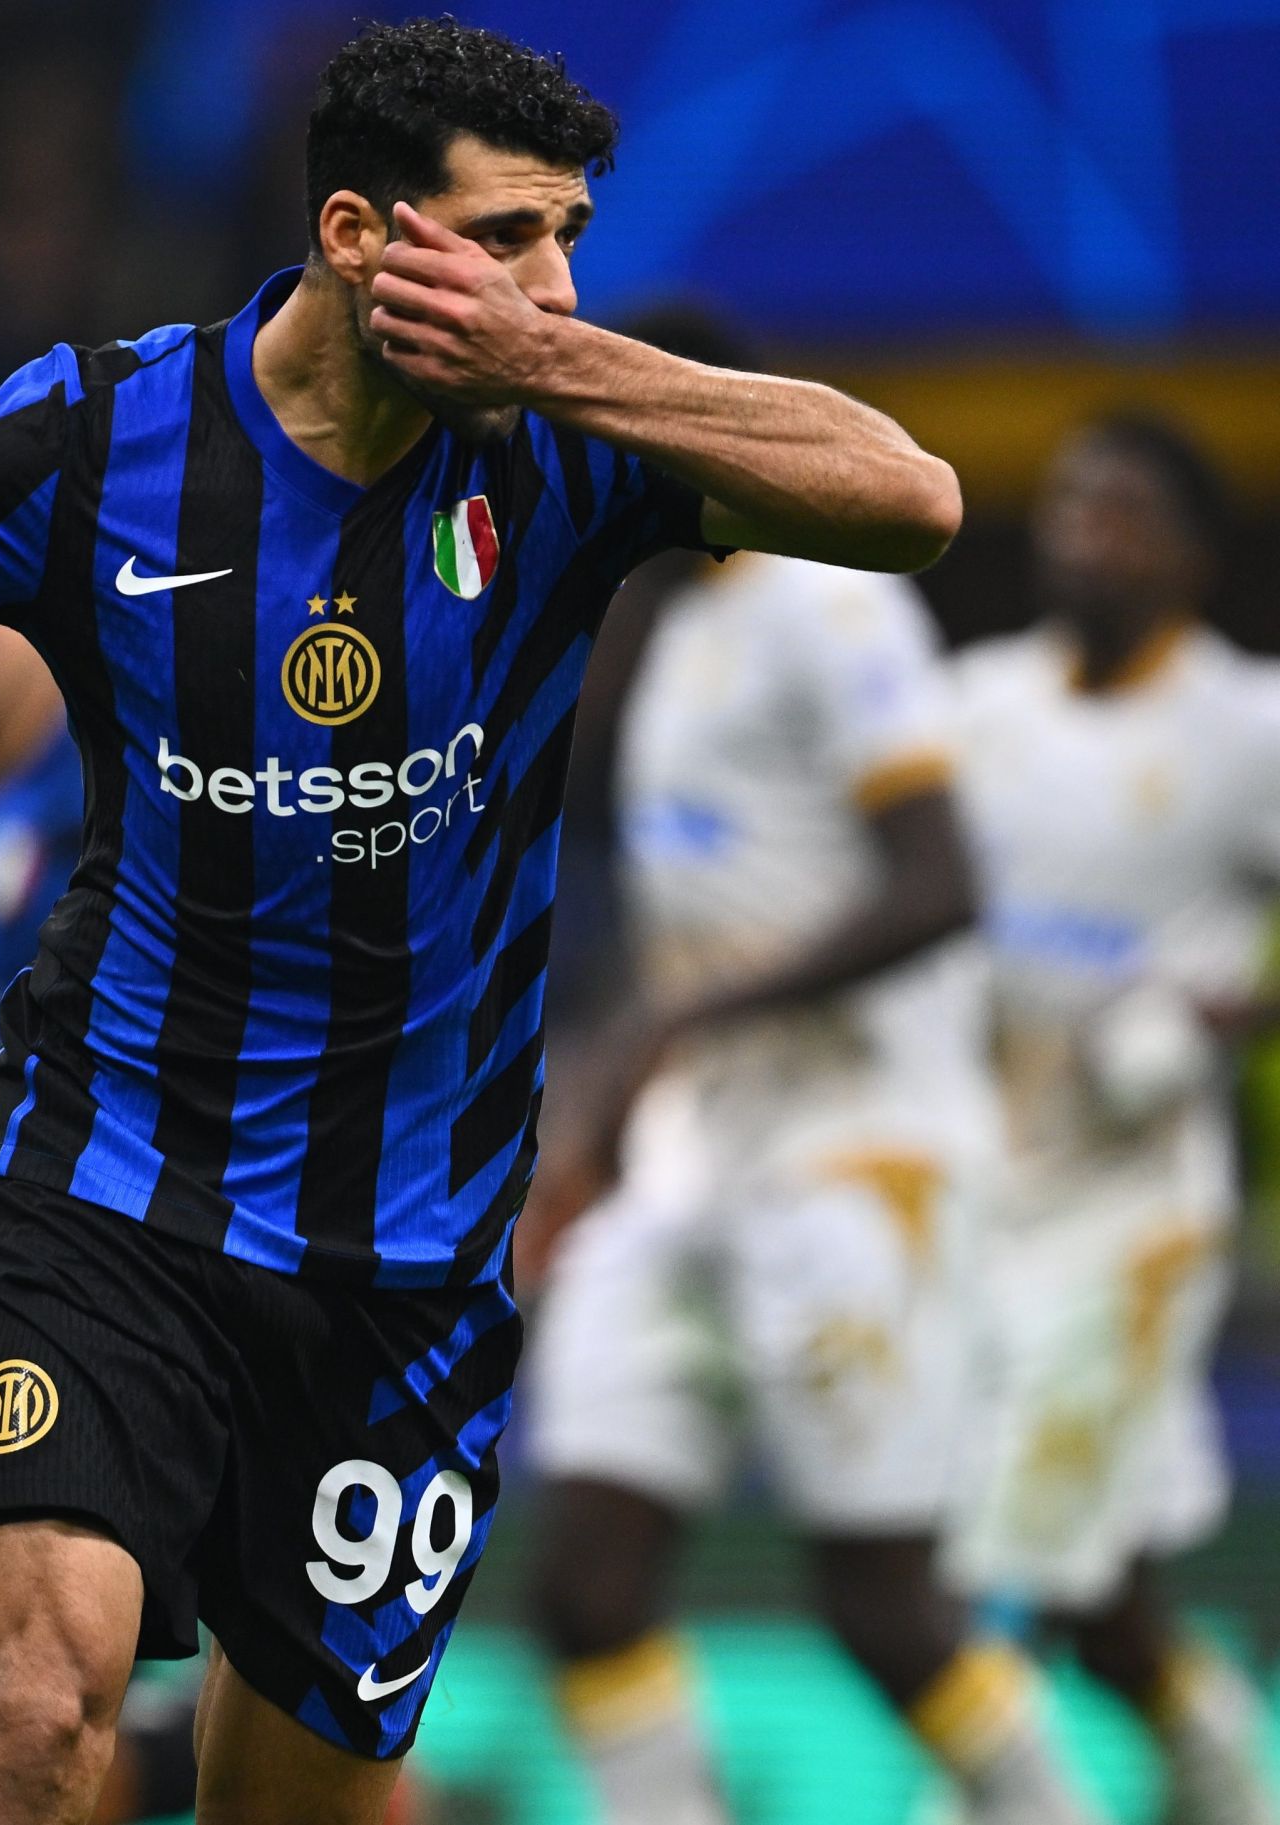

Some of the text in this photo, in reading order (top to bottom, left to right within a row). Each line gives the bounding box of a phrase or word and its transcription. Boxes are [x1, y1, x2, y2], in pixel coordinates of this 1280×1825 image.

[157, 722, 485, 817] betsson
[316, 772, 486, 870] .sport
[305, 1458, 473, 1615] 99
